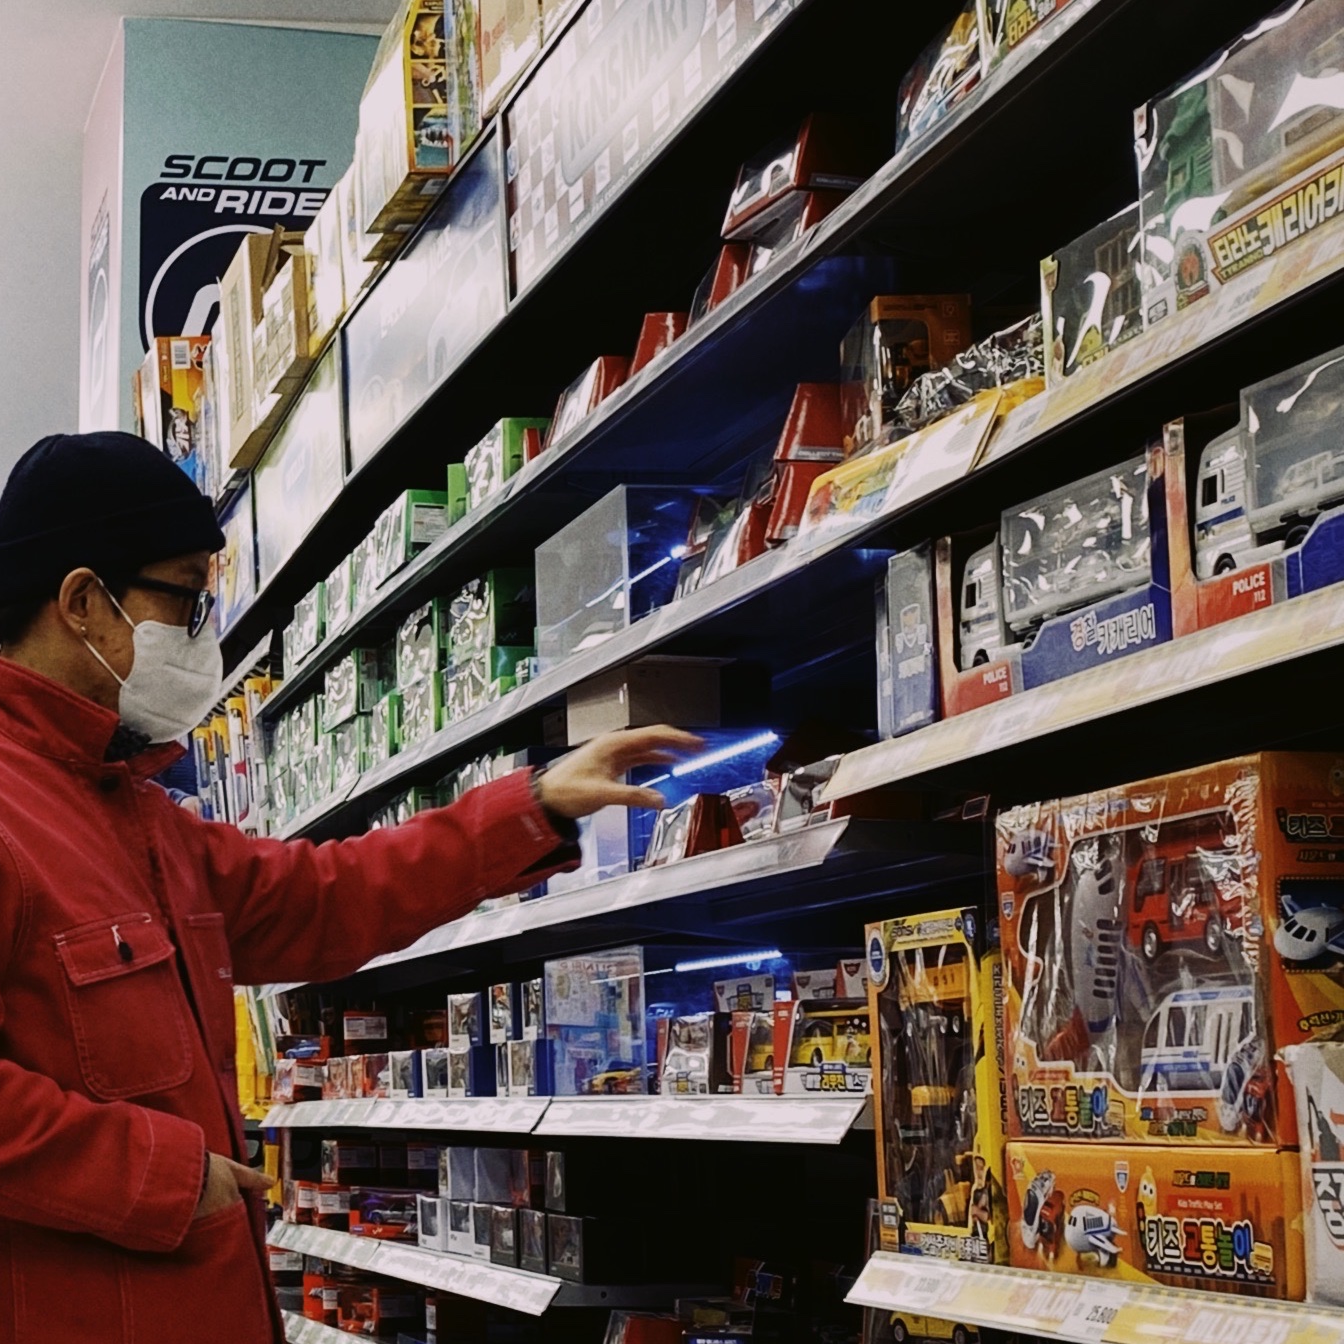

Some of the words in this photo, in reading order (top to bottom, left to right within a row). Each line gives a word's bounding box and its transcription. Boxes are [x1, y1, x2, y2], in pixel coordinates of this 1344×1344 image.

[159, 154, 327, 183] SCOOT
[159, 186, 216, 202] AND
[214, 188, 328, 216] RIDE
[1233, 571, 1266, 597] POLICE
[1253, 590, 1266, 603] 112
[1071, 610, 1098, 652] 경찰
[1096, 603, 1156, 655] 카캐리어
[983, 666, 1007, 685] POLICE
[1289, 815, 1327, 836] 키즈
[1020, 1086, 1049, 1127] 키즈
[1050, 1085, 1108, 1130] 교통놀이
[1145, 1217, 1181, 1262] 키즈
[1183, 1221, 1253, 1277] 교통놀이
